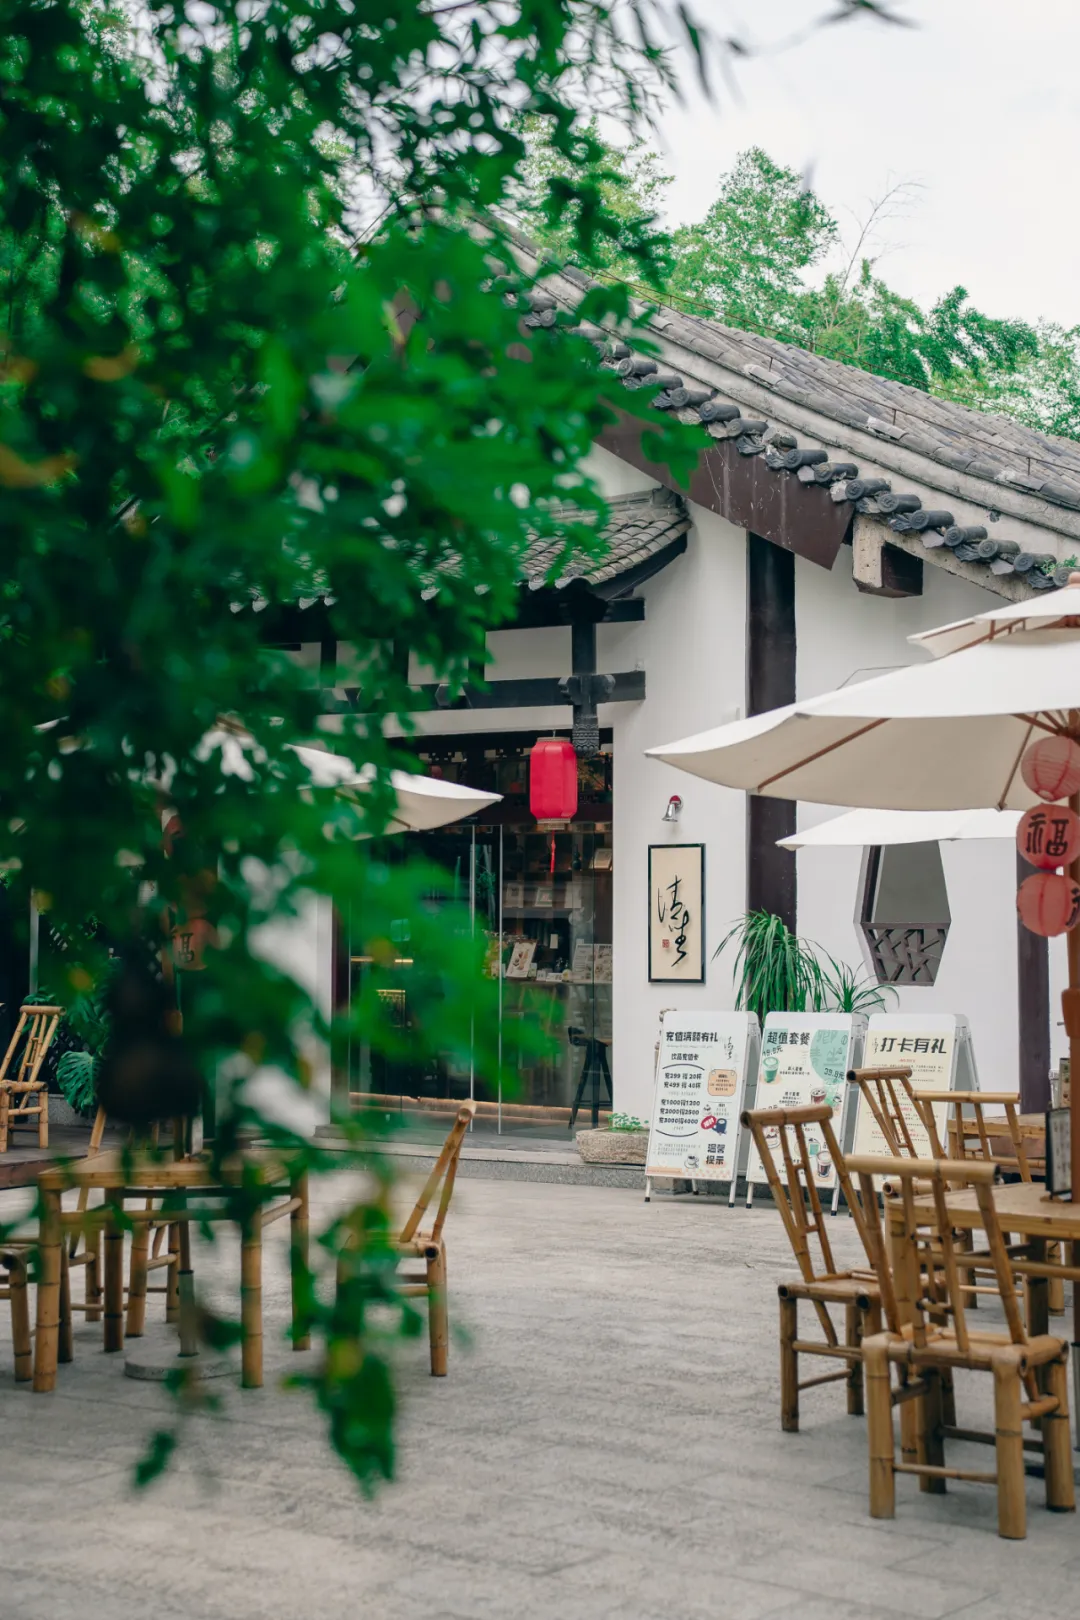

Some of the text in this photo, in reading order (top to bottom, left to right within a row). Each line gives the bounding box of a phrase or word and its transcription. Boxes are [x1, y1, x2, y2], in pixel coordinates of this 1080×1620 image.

[1026, 813, 1069, 857] 福
[666, 1031, 718, 1042] 充值满额有礼
[767, 1031, 810, 1046] 超值套餐
[880, 1037, 947, 1054] 打卡有礼
